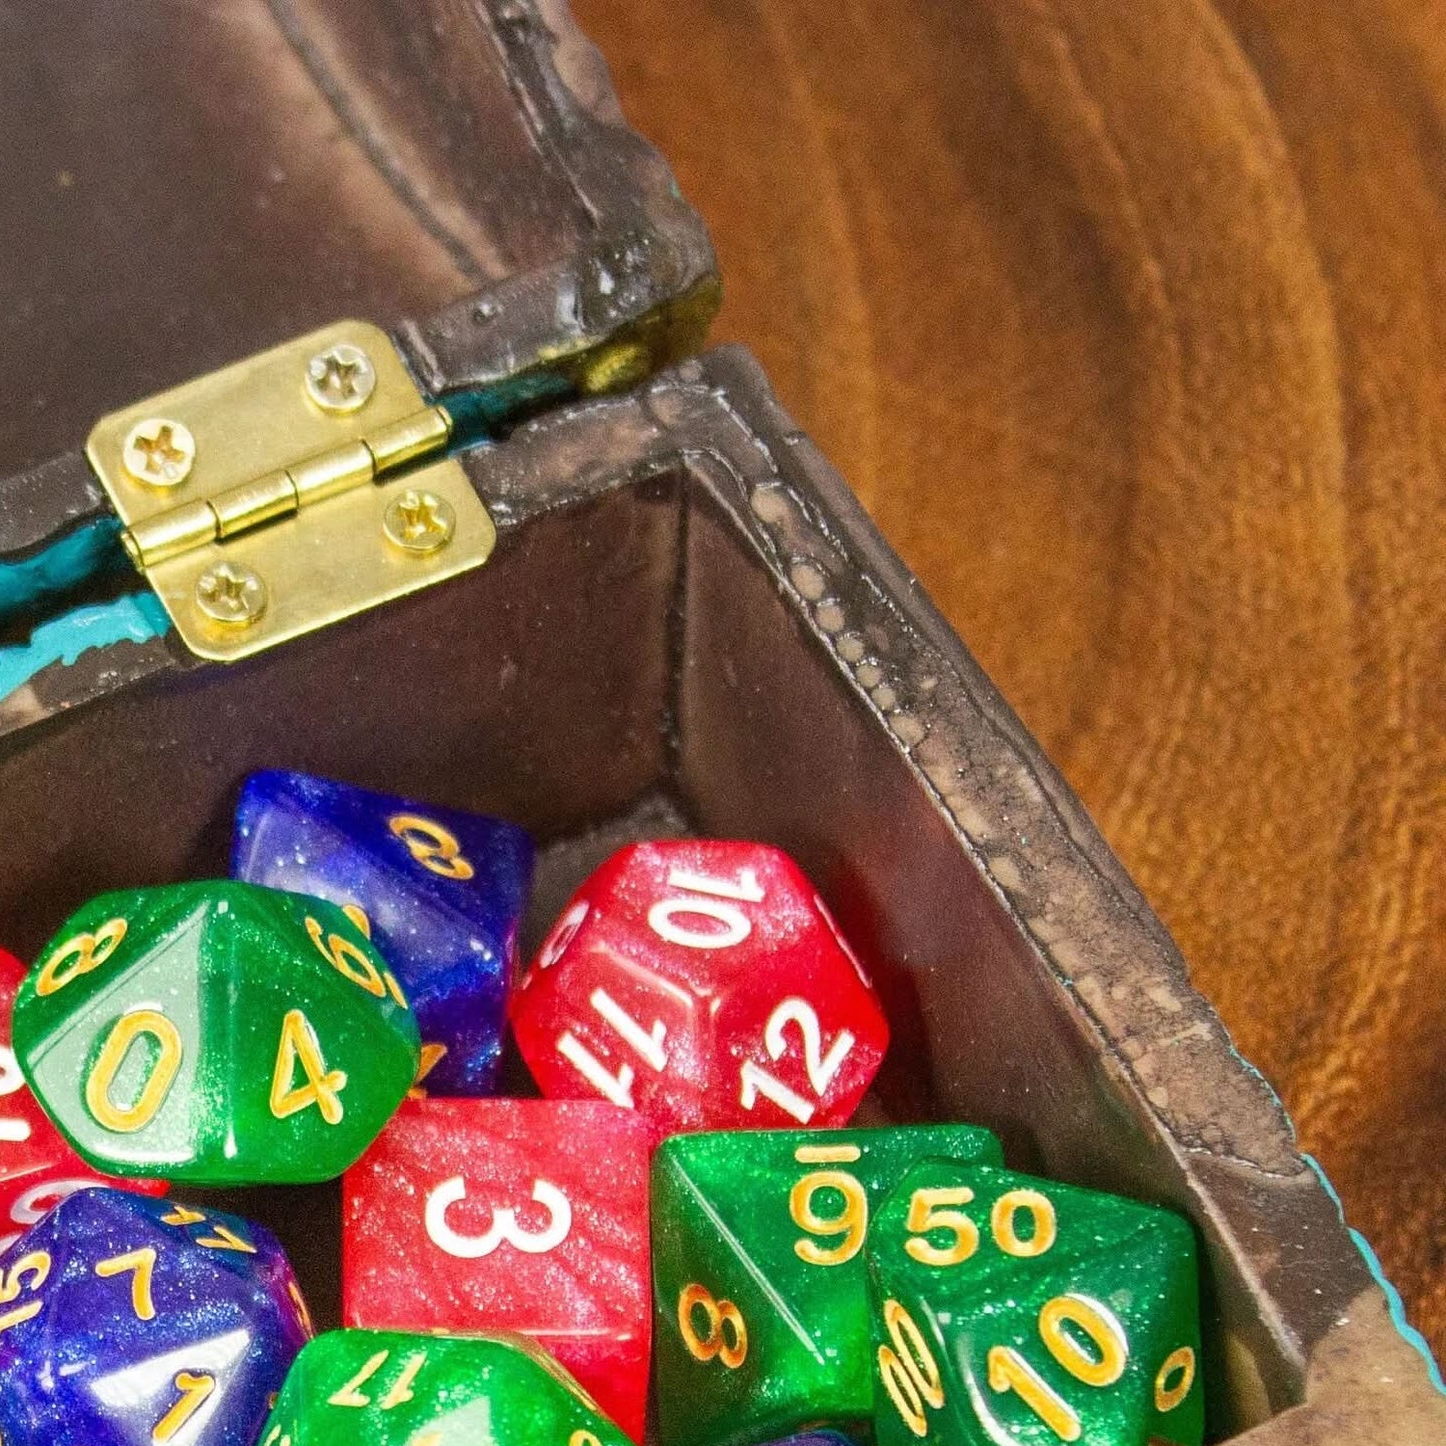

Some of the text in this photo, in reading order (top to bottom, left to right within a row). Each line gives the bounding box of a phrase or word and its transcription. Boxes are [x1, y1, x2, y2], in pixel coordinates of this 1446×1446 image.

[390, 813, 474, 879] 8
[648, 868, 765, 949] 10
[36, 917, 128, 996] 8
[85, 1008, 183, 1134] 0
[270, 1009, 347, 1124] 4
[557, 987, 667, 1108] 11
[741, 995, 855, 1124] 12
[425, 1176, 572, 1258] 3
[904, 1186, 1055, 1266] 50
[95, 1247, 156, 1321] 7
[678, 1284, 748, 1368] 8
[153, 1368, 217, 1443] 1
[328, 1349, 426, 1410] 17
[878, 1300, 945, 1437] 00
[988, 1294, 1127, 1442] 10
